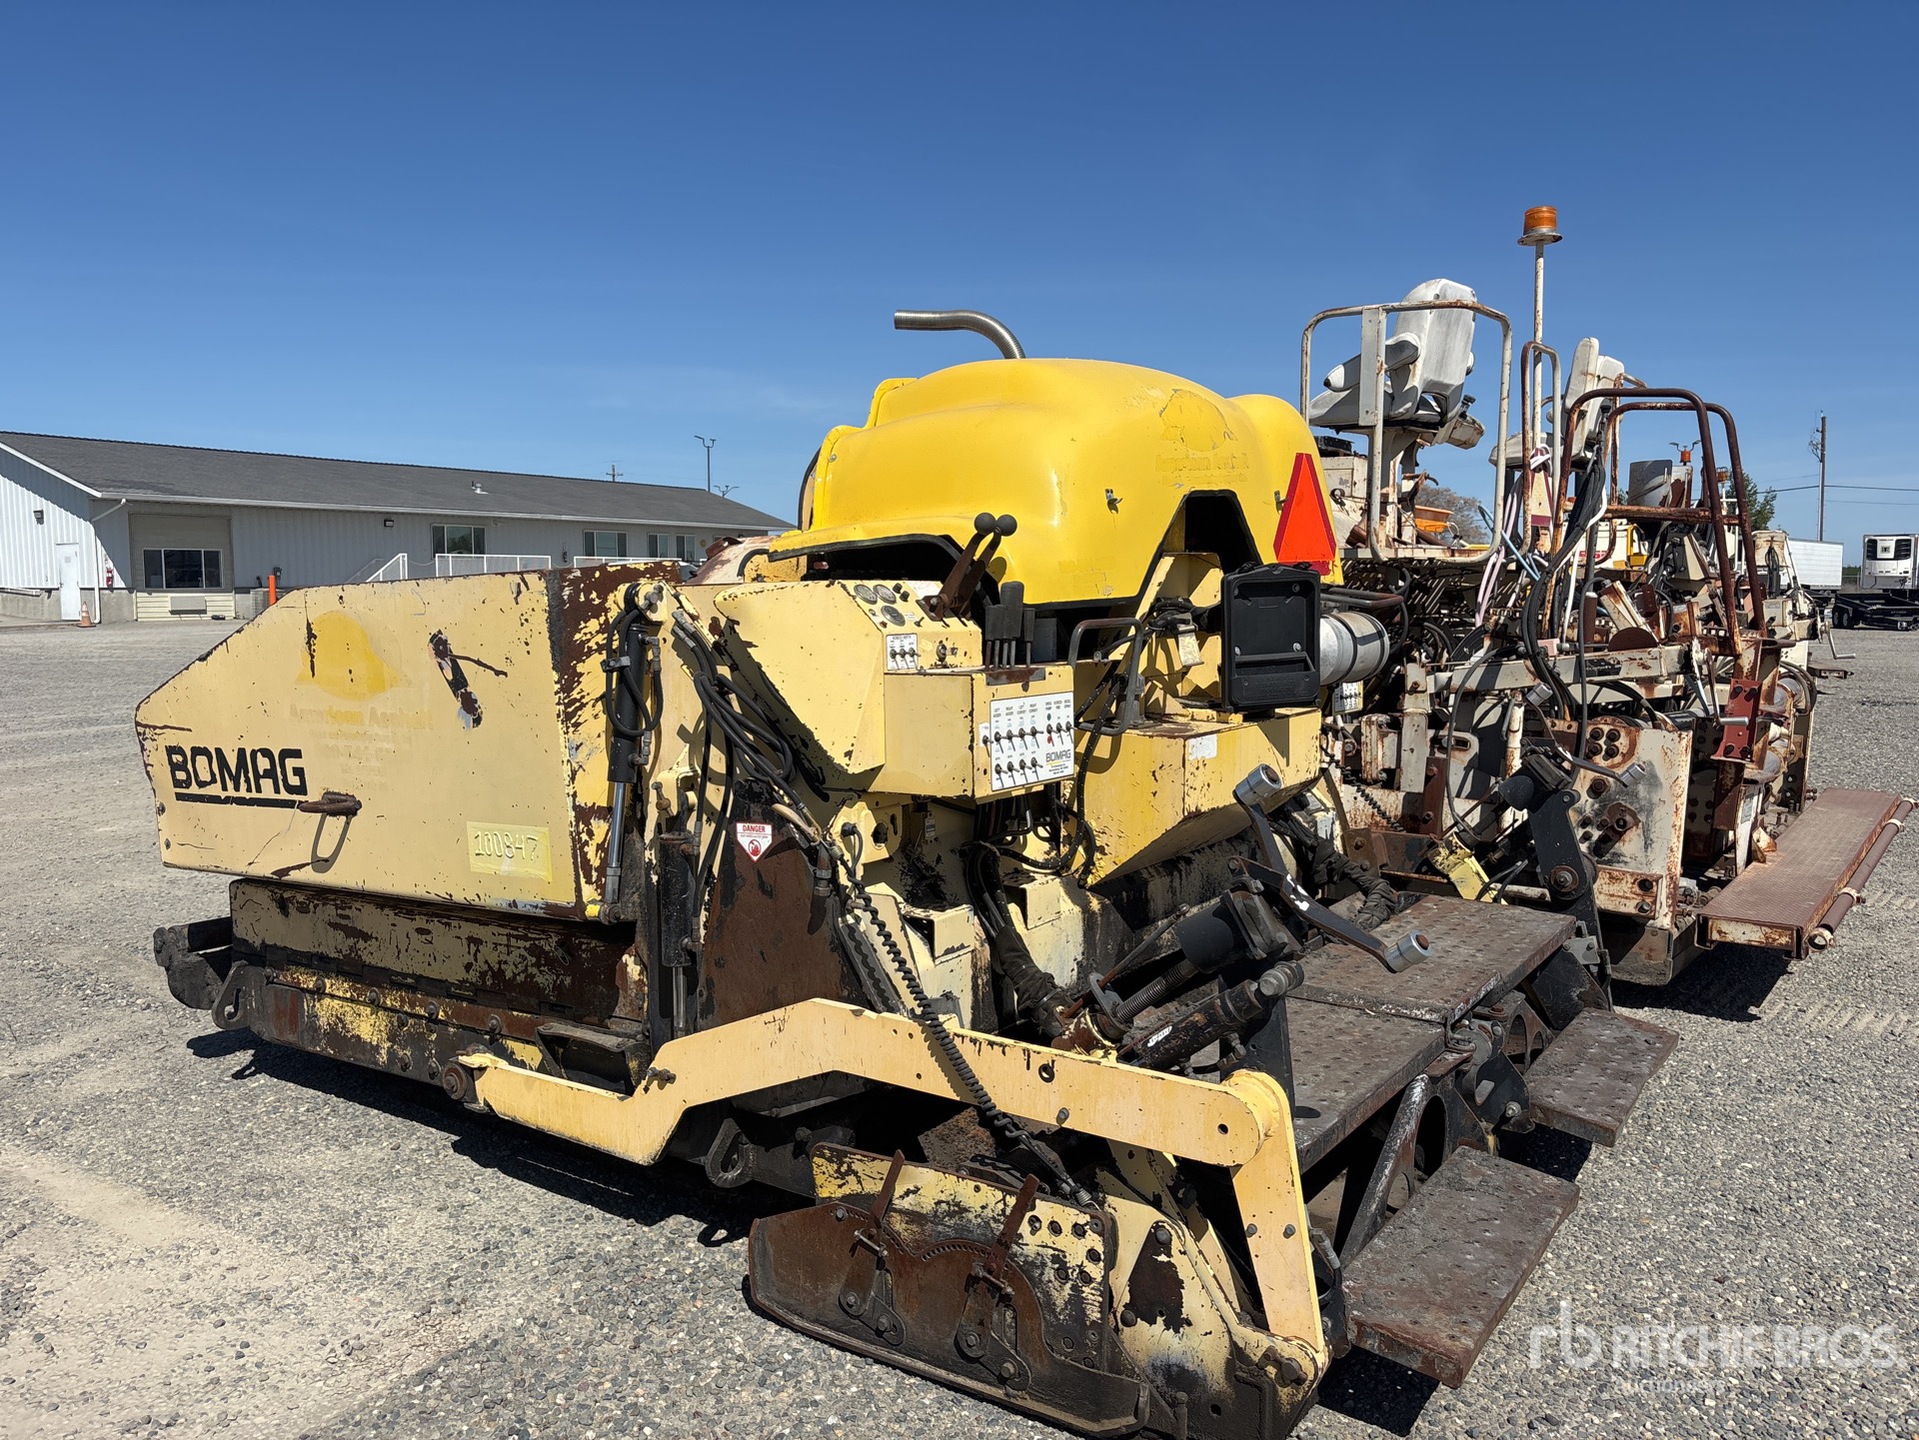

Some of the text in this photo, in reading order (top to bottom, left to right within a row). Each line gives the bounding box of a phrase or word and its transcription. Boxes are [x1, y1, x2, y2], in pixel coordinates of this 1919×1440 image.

[165, 745, 308, 796] BOMAG
[1045, 749, 1071, 762] BOMAG
[474, 831, 539, 861] 100847
